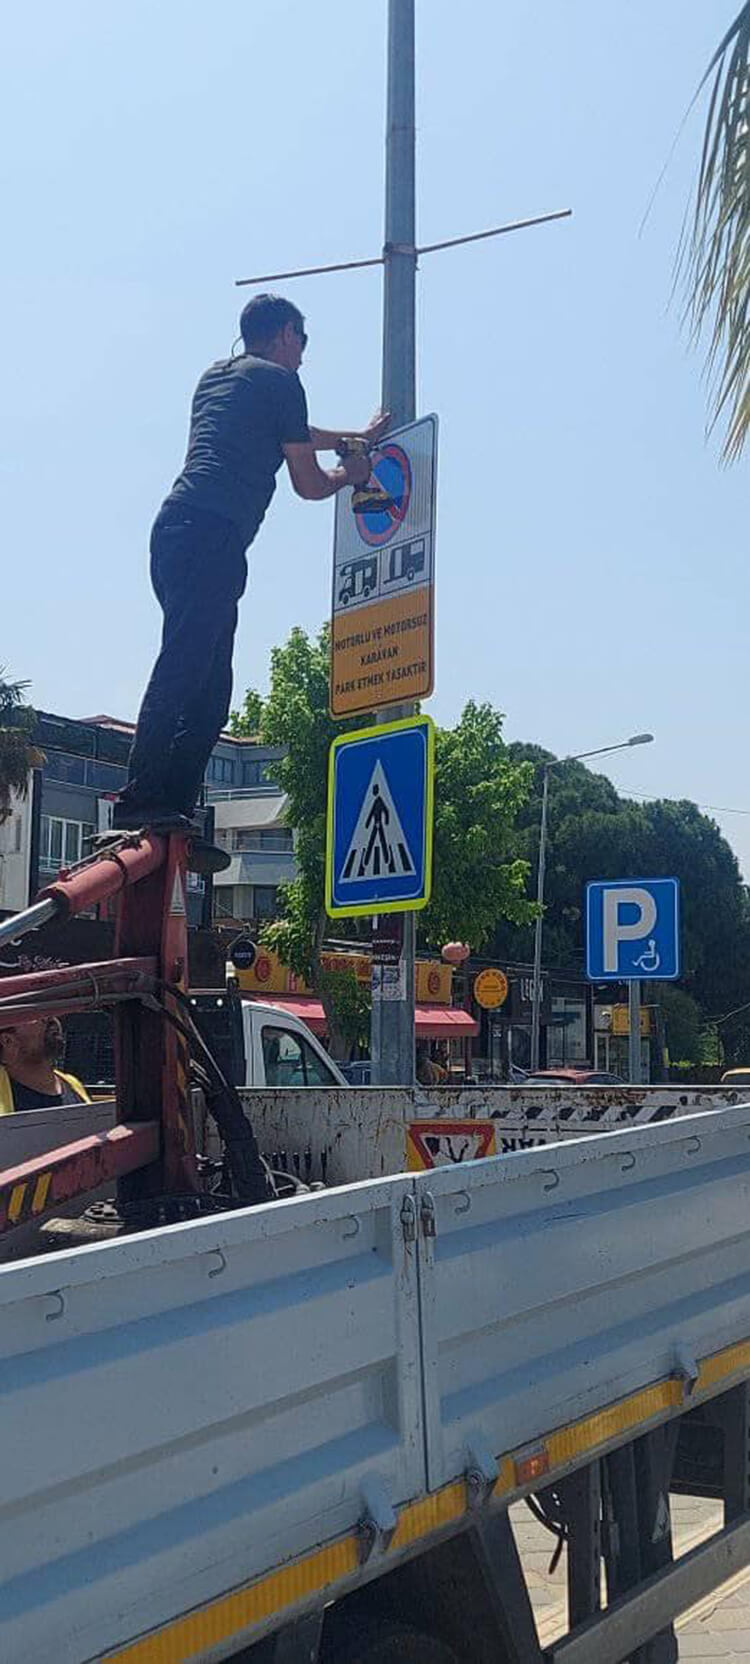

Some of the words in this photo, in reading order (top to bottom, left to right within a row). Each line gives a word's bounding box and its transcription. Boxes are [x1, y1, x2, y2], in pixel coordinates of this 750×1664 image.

[335, 632, 371, 652] MOTORLU
[372, 627, 382, 641] VE
[383, 613, 428, 637] MOTORSUZ
[360, 646, 399, 666] KARAVAN
[335, 681, 356, 695] PARK
[357, 672, 384, 690] ETMEK
[385, 661, 427, 682] YASAKTIR
[603, 888, 657, 972] P
